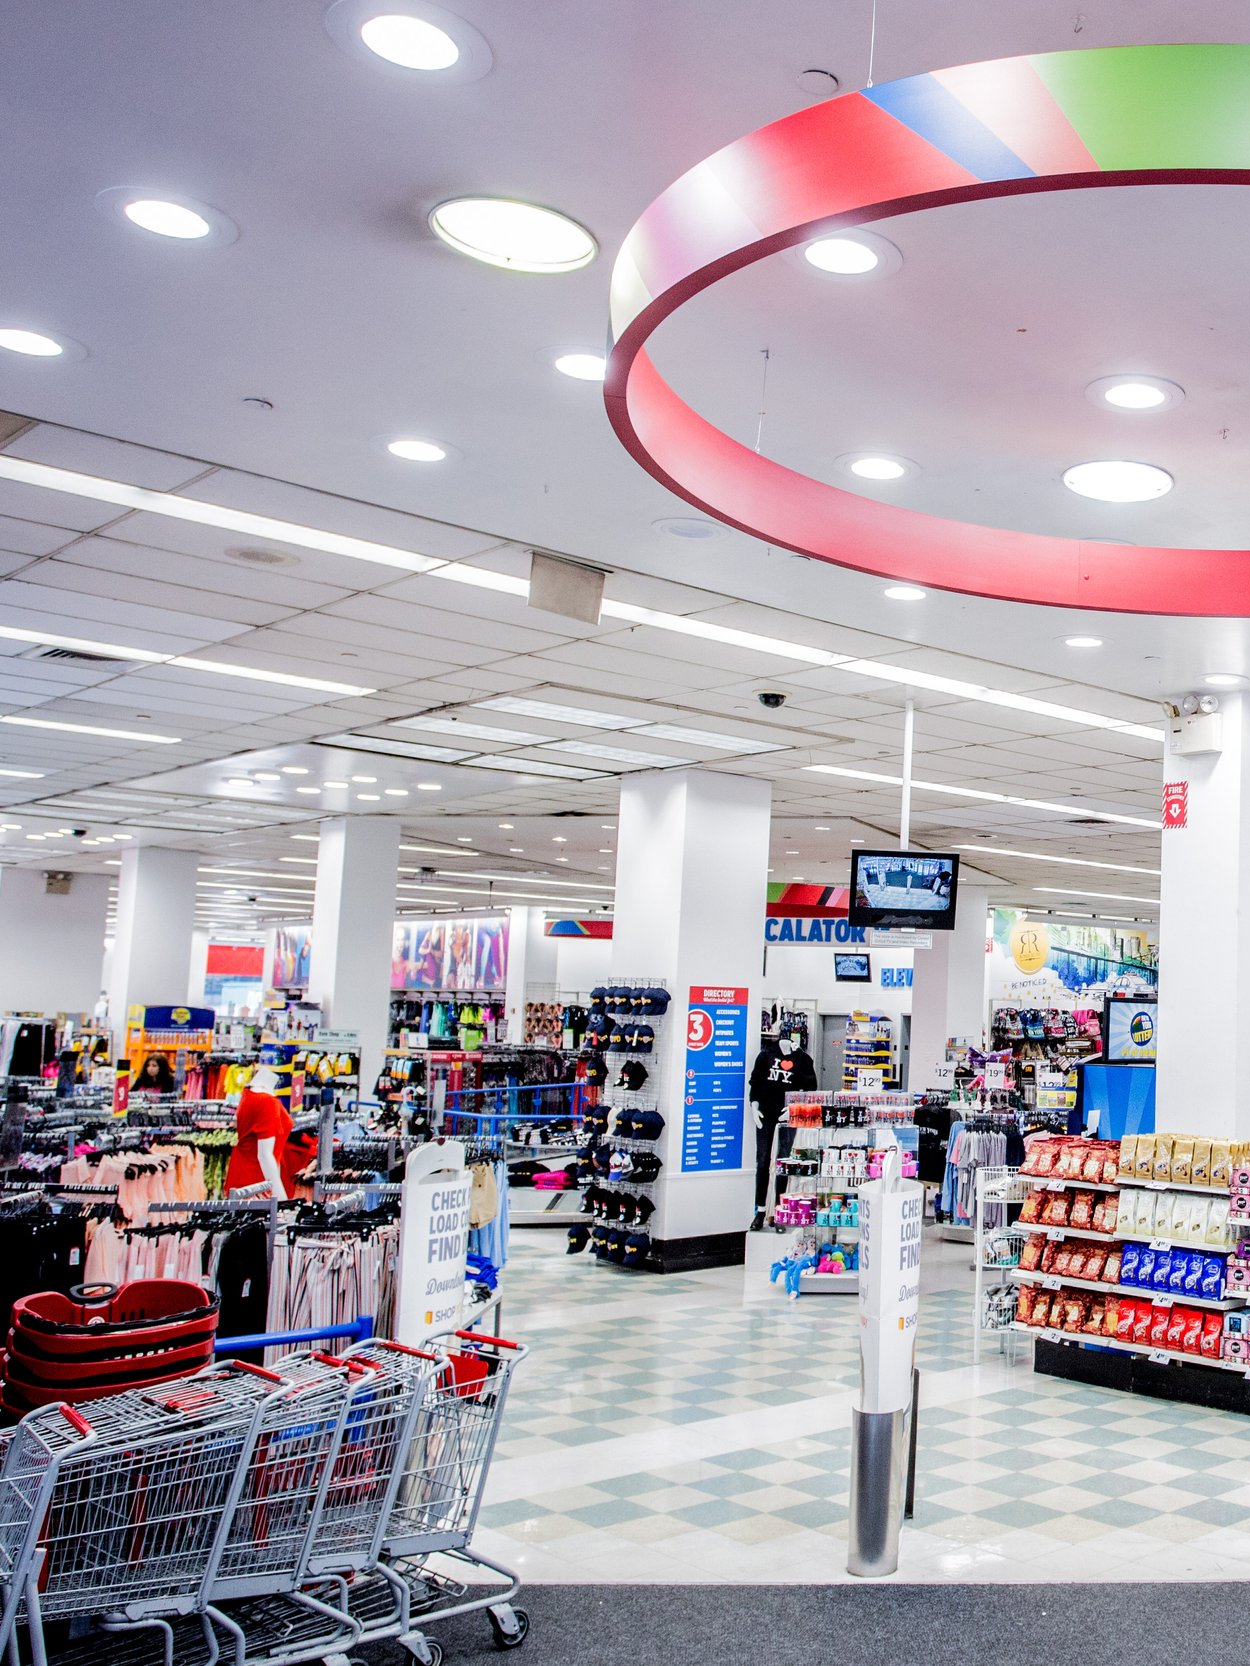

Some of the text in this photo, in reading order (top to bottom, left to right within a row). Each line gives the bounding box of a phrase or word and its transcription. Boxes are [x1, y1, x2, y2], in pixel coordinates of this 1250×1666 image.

[1168, 786, 1184, 794] FIRE
[704, 989, 735, 998] DIRECTORY
[689, 1014, 704, 1041] 3
[767, 1068, 795, 1084] NY
[431, 1188, 467, 1212] CHECK
[429, 1212, 459, 1235] LOAD
[427, 1234, 461, 1264] FIND
